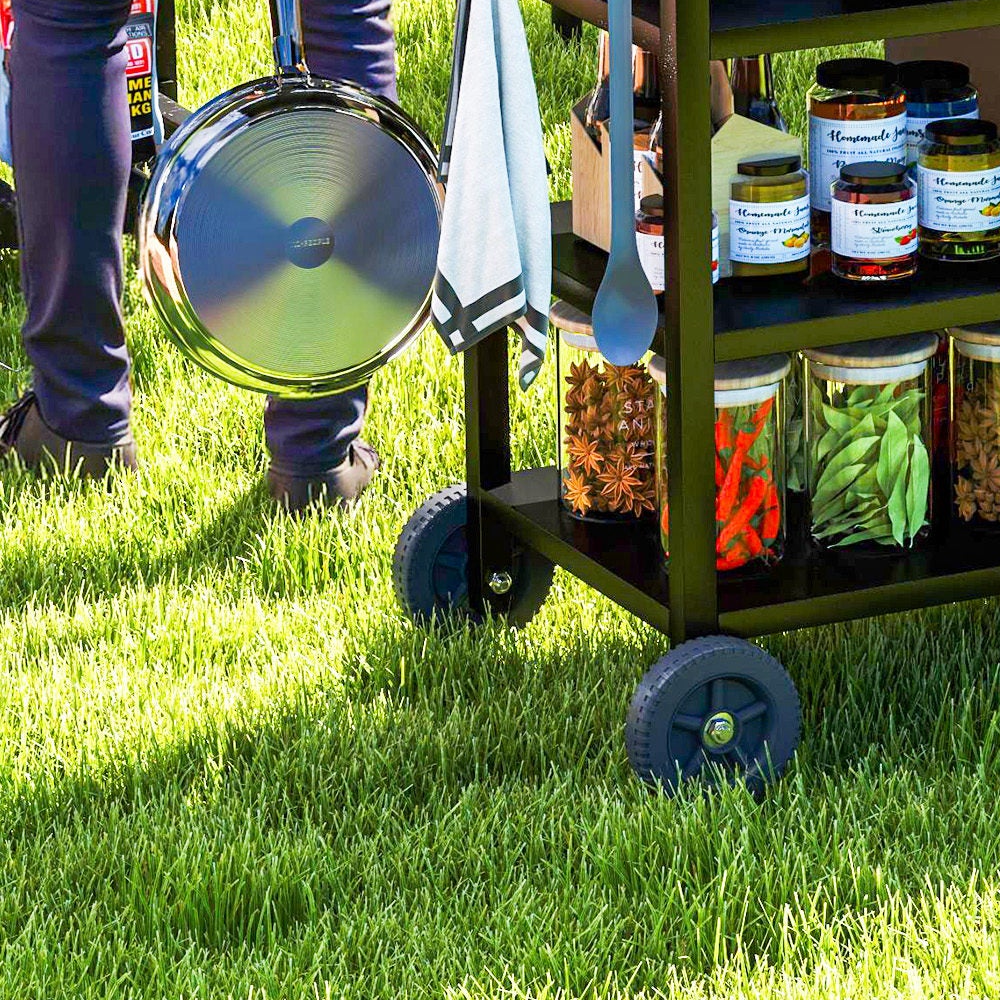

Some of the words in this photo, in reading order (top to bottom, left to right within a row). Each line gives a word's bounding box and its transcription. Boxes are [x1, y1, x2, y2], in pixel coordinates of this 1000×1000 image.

[131, 101, 151, 117] KG
[827, 129, 891, 143] Homemade
[933, 177, 988, 187] Homemade
[933, 196, 967, 206] Orange
[735, 208, 791, 218] Homemade
[854, 207, 905, 217] Homemade
[736, 227, 768, 237] Orange
[624, 396, 654, 414] STA
[619, 417, 651, 432] ANI
